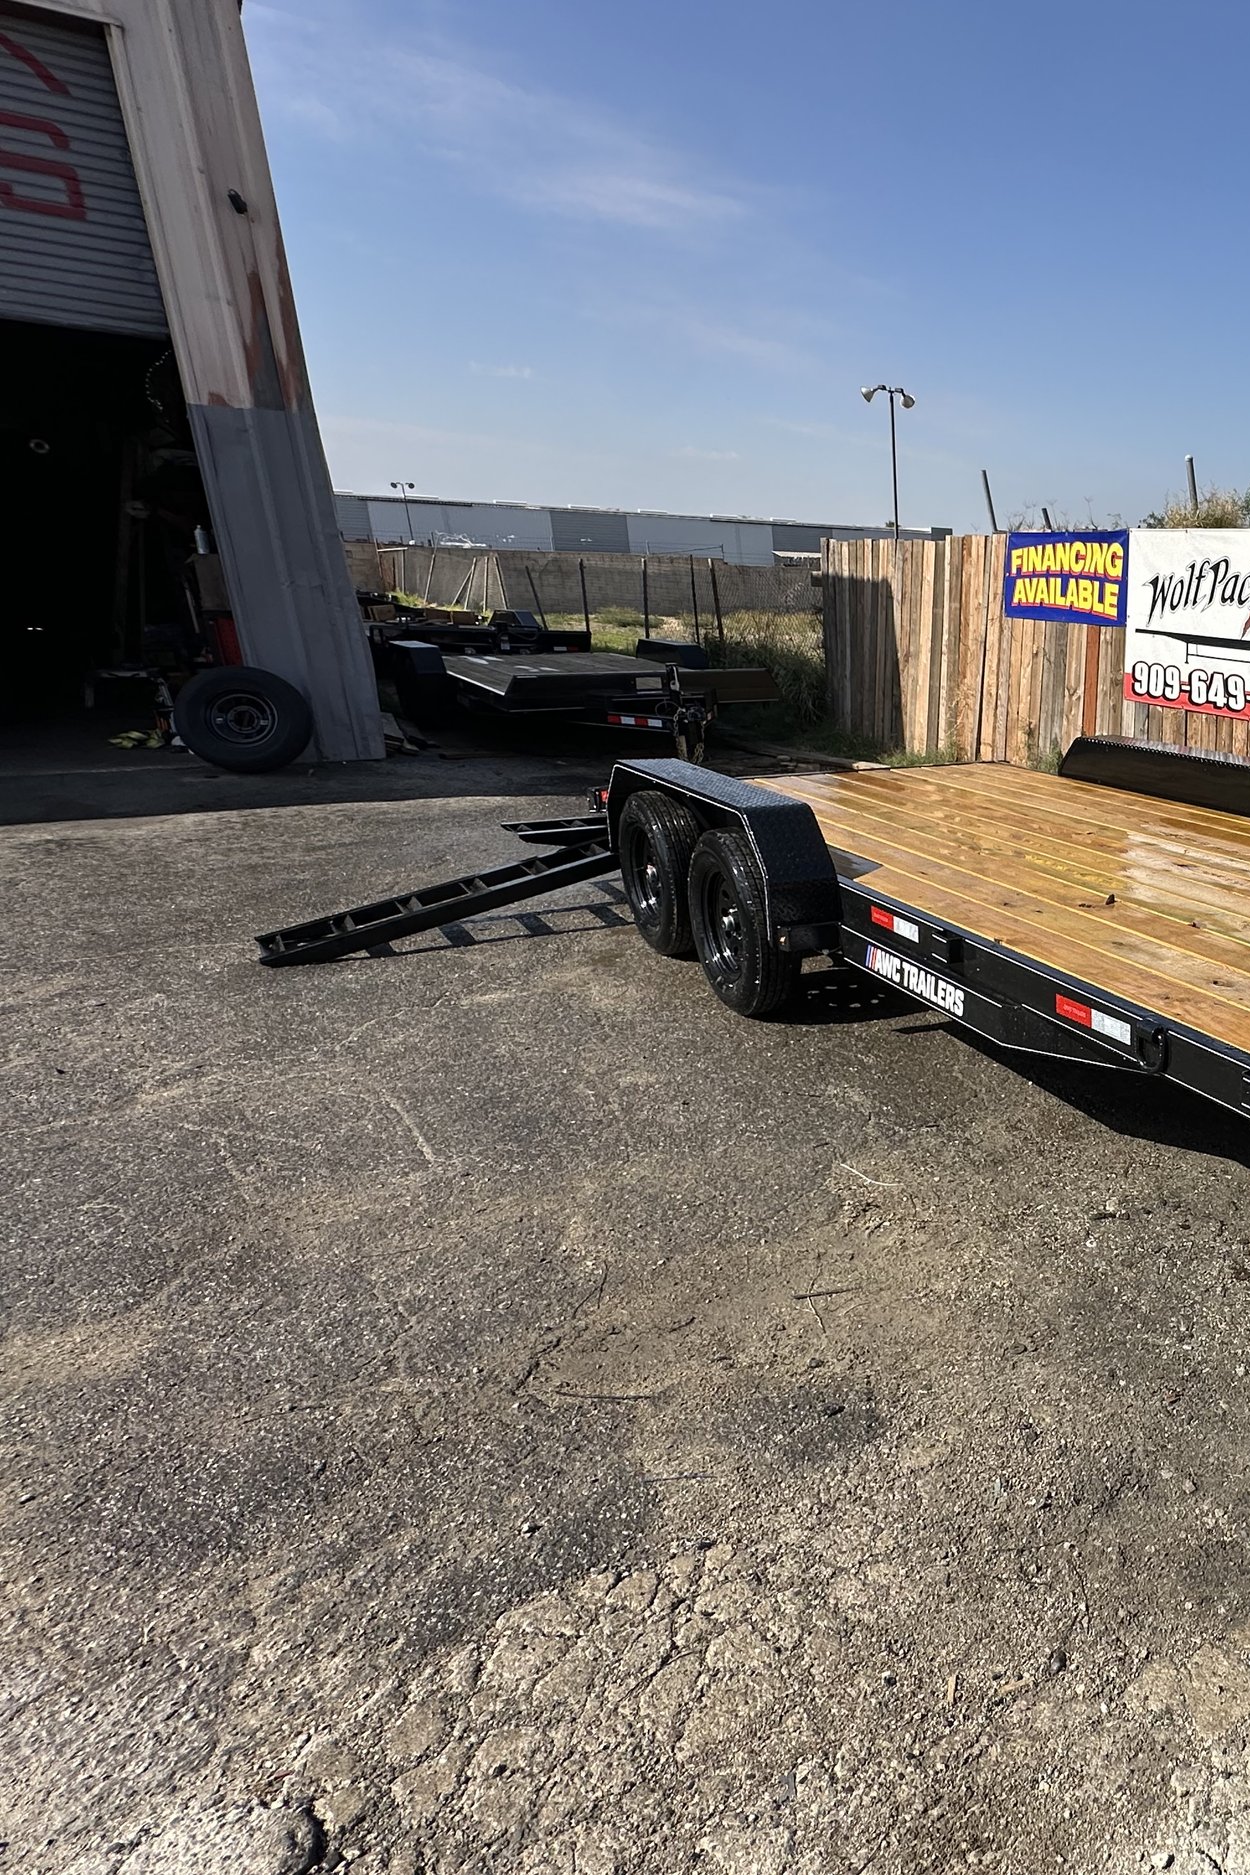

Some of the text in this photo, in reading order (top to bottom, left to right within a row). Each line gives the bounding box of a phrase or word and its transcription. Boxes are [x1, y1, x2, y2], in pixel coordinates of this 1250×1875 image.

[1010, 541, 1124, 580] FINANCING
[1011, 577, 1119, 620] AVAILABLE
[874, 948, 965, 1017] AWC TRAILERS
